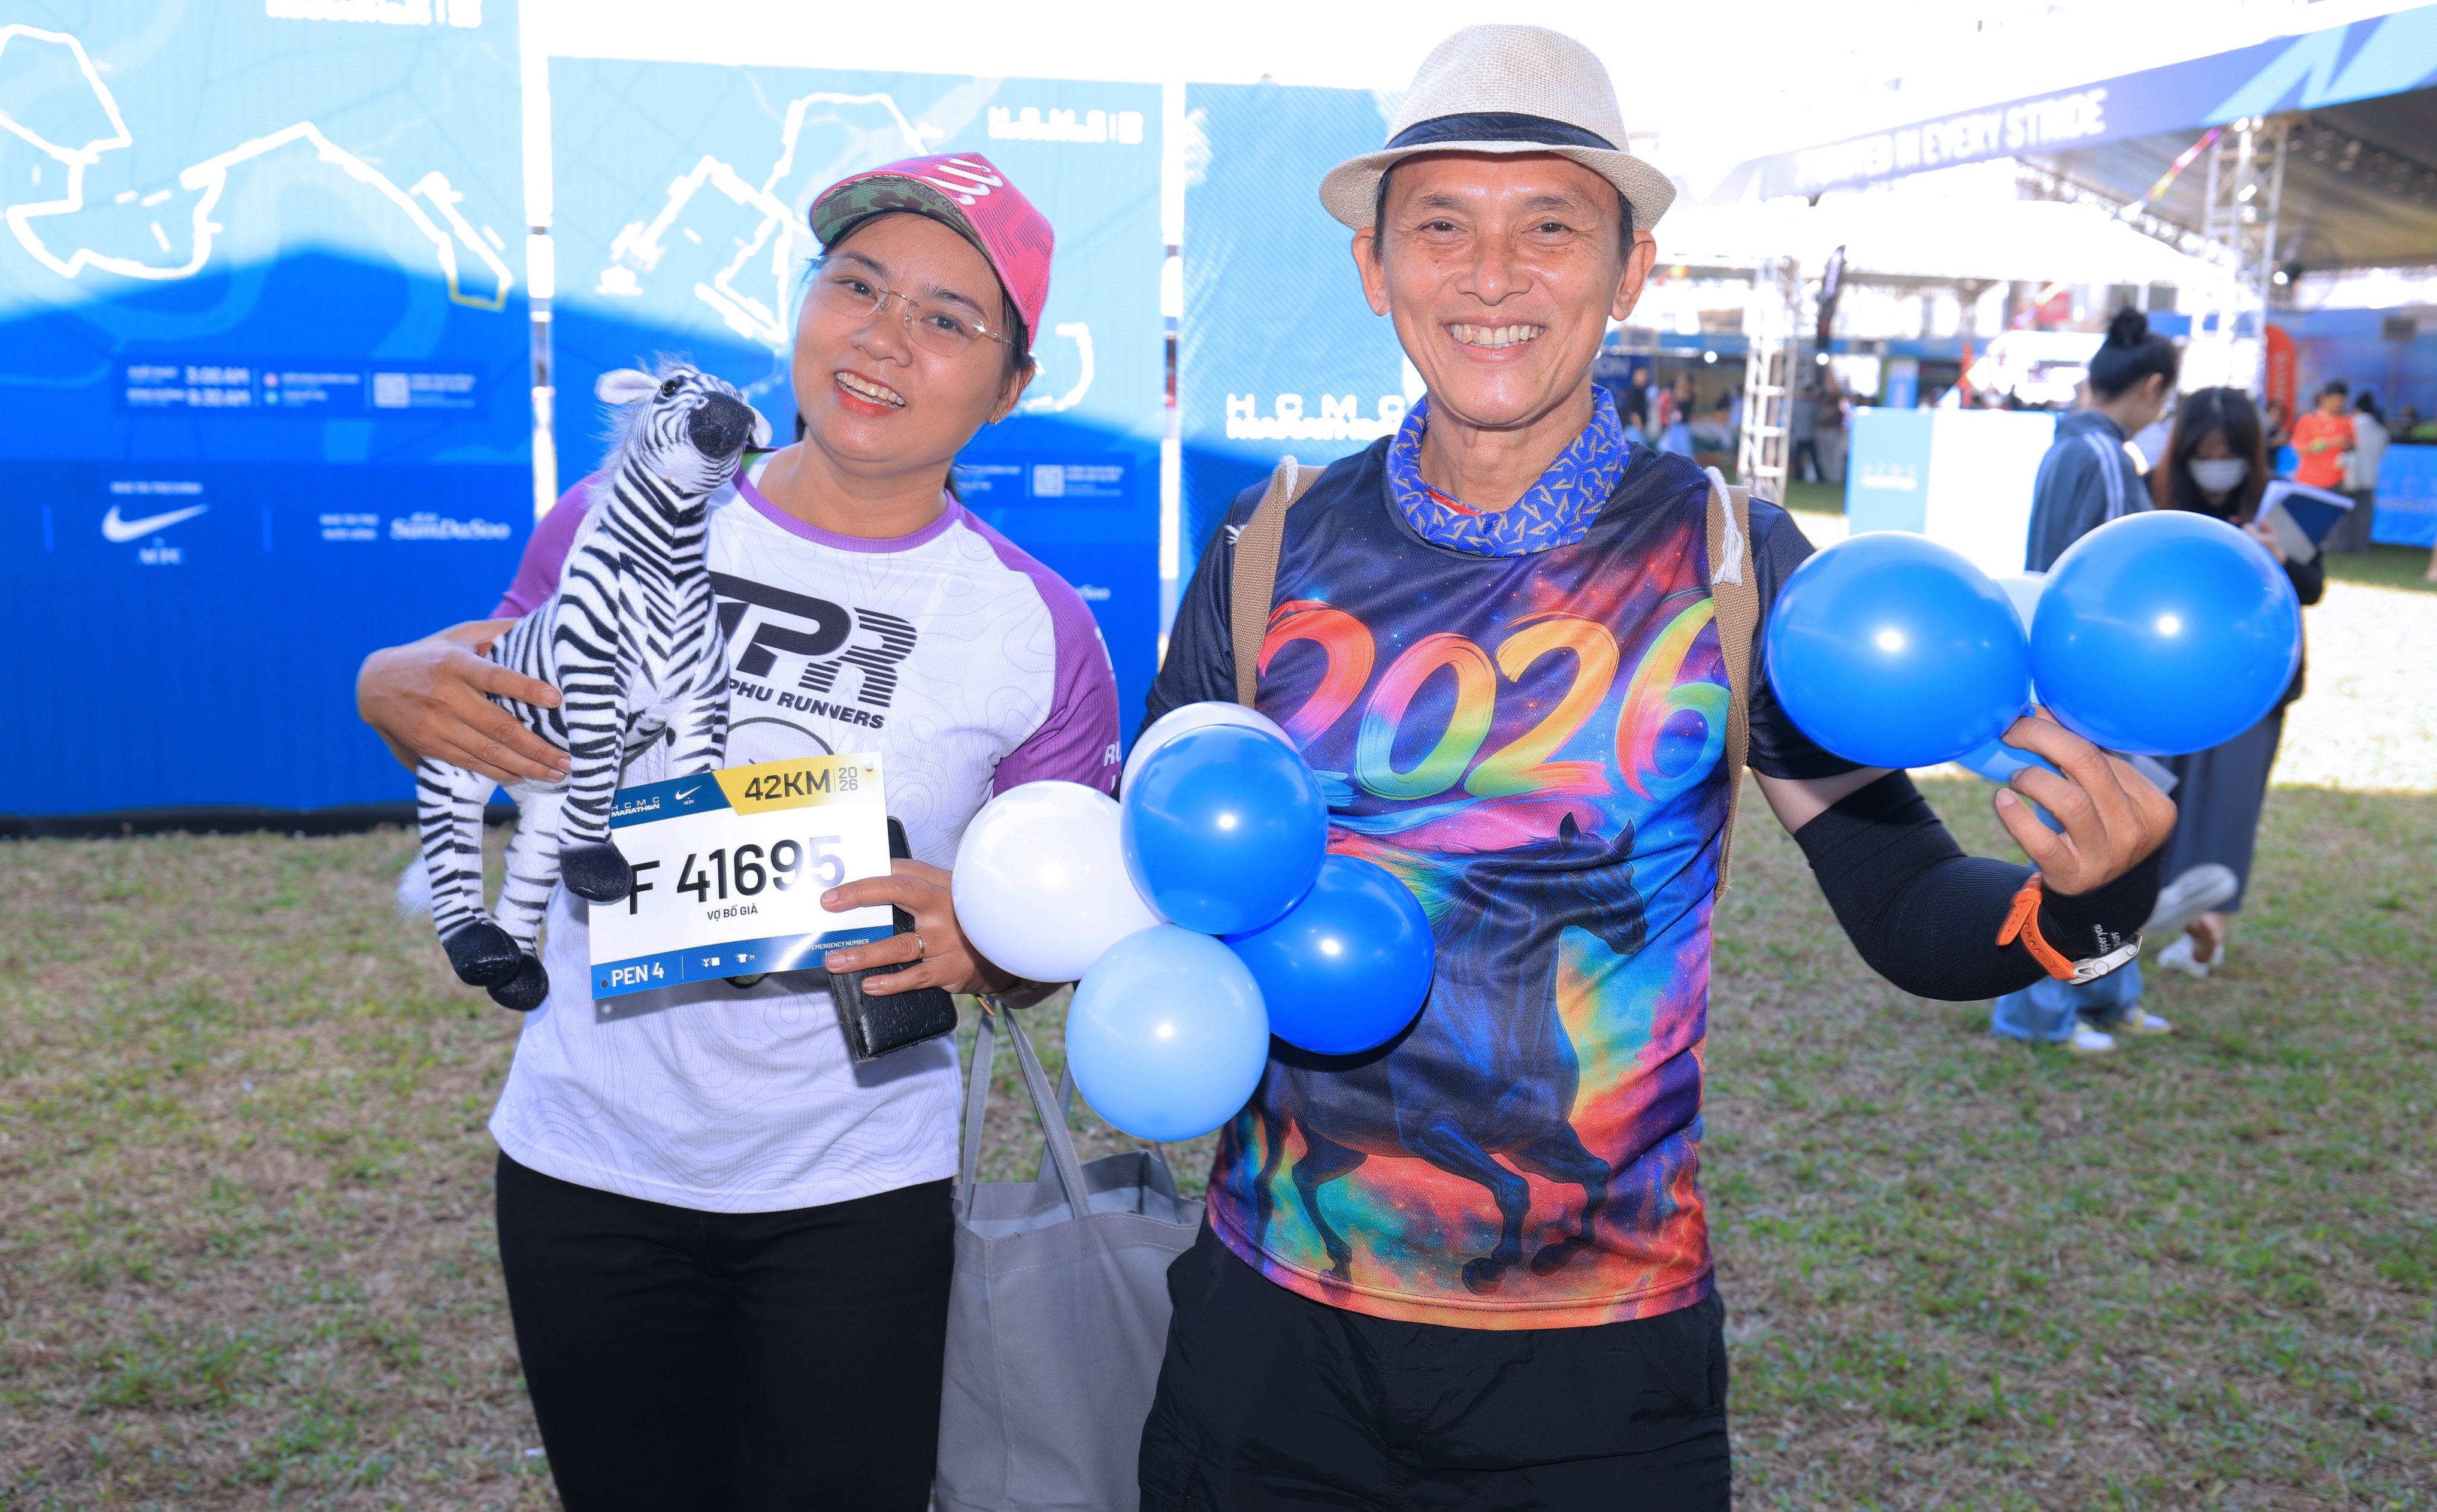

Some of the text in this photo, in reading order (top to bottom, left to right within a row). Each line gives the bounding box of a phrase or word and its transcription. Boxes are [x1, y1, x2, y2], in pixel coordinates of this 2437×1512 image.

[777, 691, 885, 729] RUNNERS
[1257, 595, 1731, 806] 2026
[745, 769, 831, 801] 42KM
[838, 766, 858, 779] 20
[839, 779, 858, 791] 26
[630, 835, 845, 915] F 41695
[707, 903, 758, 921] VỢ BỐ GIÀ
[612, 962, 664, 987] PEN 4
